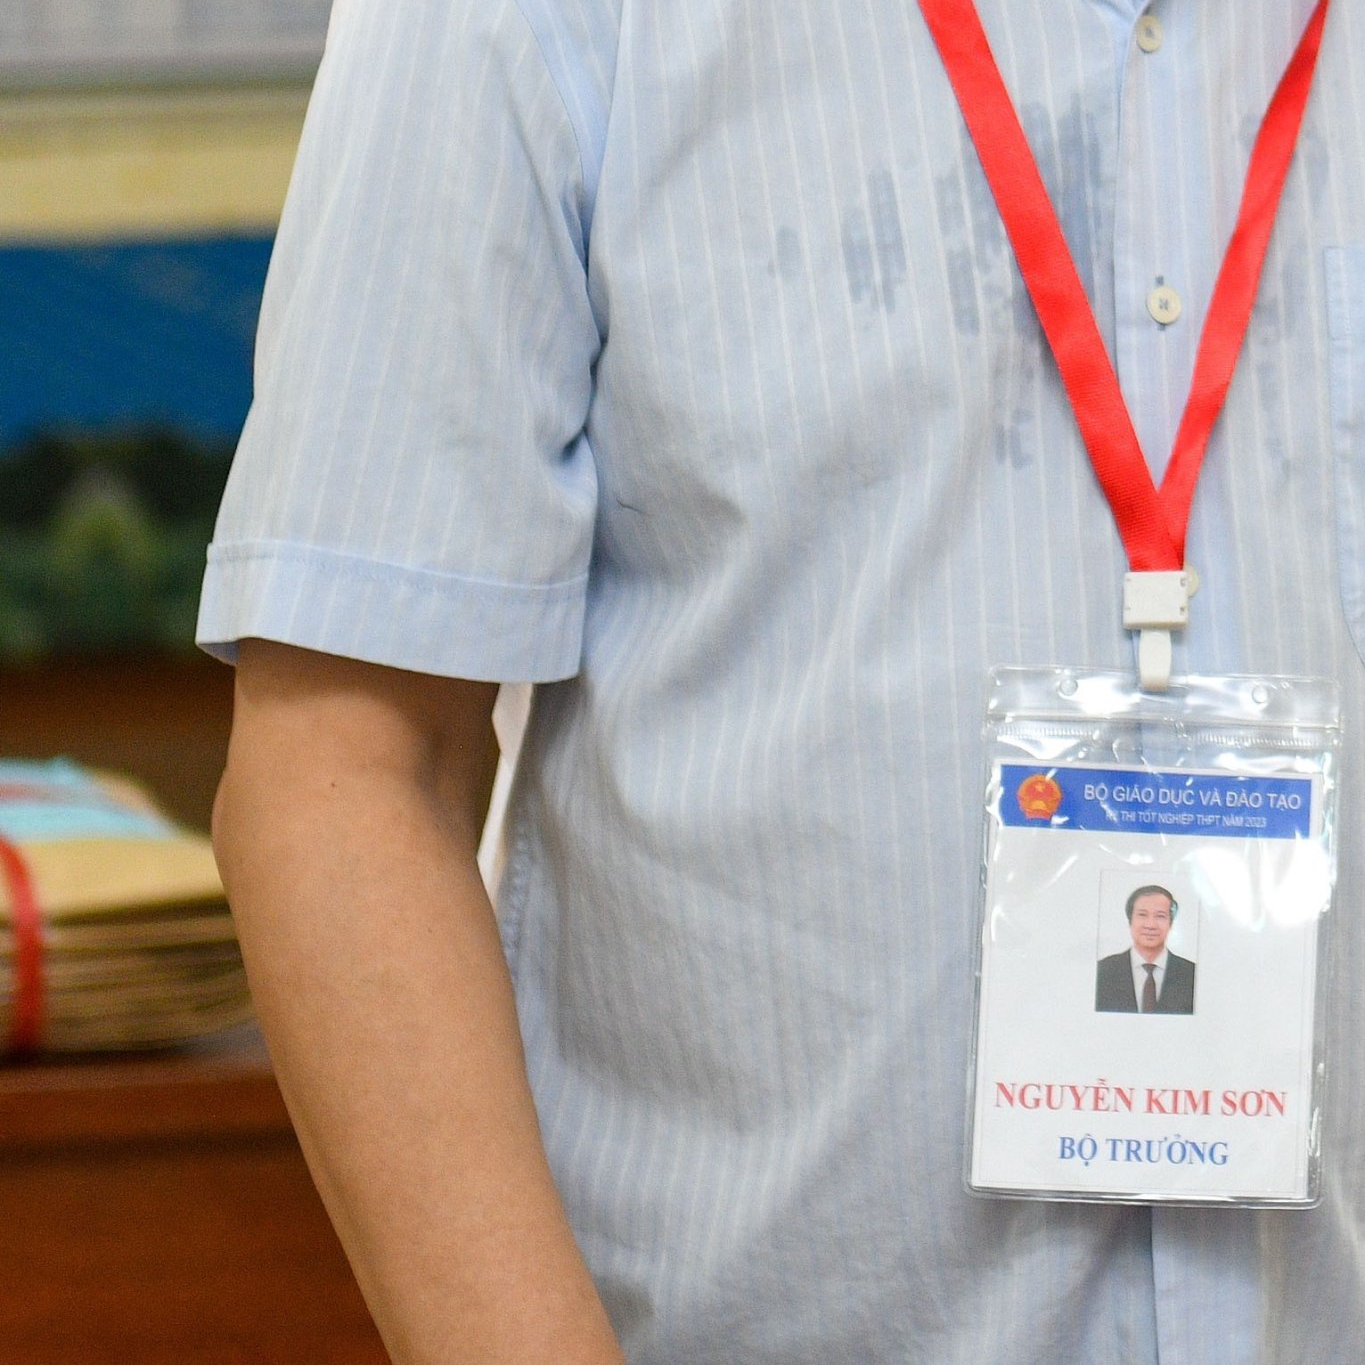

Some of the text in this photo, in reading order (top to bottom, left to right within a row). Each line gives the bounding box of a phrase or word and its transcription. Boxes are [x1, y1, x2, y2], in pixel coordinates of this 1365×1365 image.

[1084, 783, 1301, 811] BỘ GIÁO DỤC VÀ ĐÀO TẠO
[994, 1078, 1287, 1116] NGUYỄN KIM SƠN
[1059, 1133, 1229, 1167] BỘ TRƯỞNG
